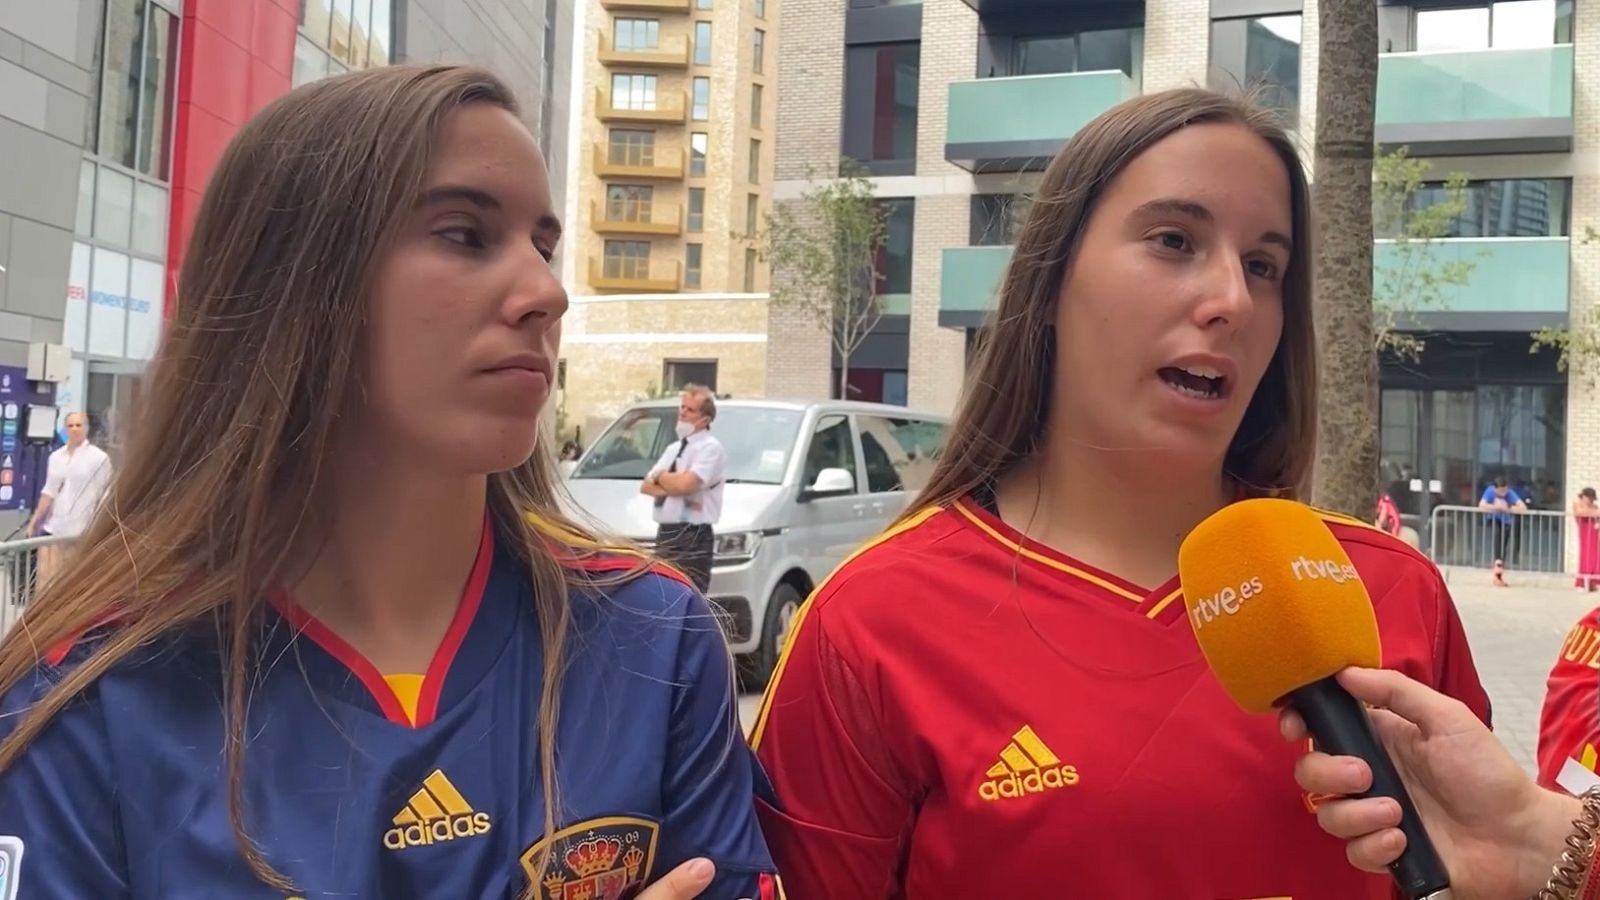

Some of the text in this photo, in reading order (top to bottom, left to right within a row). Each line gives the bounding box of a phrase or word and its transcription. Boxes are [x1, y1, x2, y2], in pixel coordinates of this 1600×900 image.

[1192, 575, 1264, 629] rtve.es
[978, 763, 1080, 801] adidas
[383, 811, 492, 850] adidas
